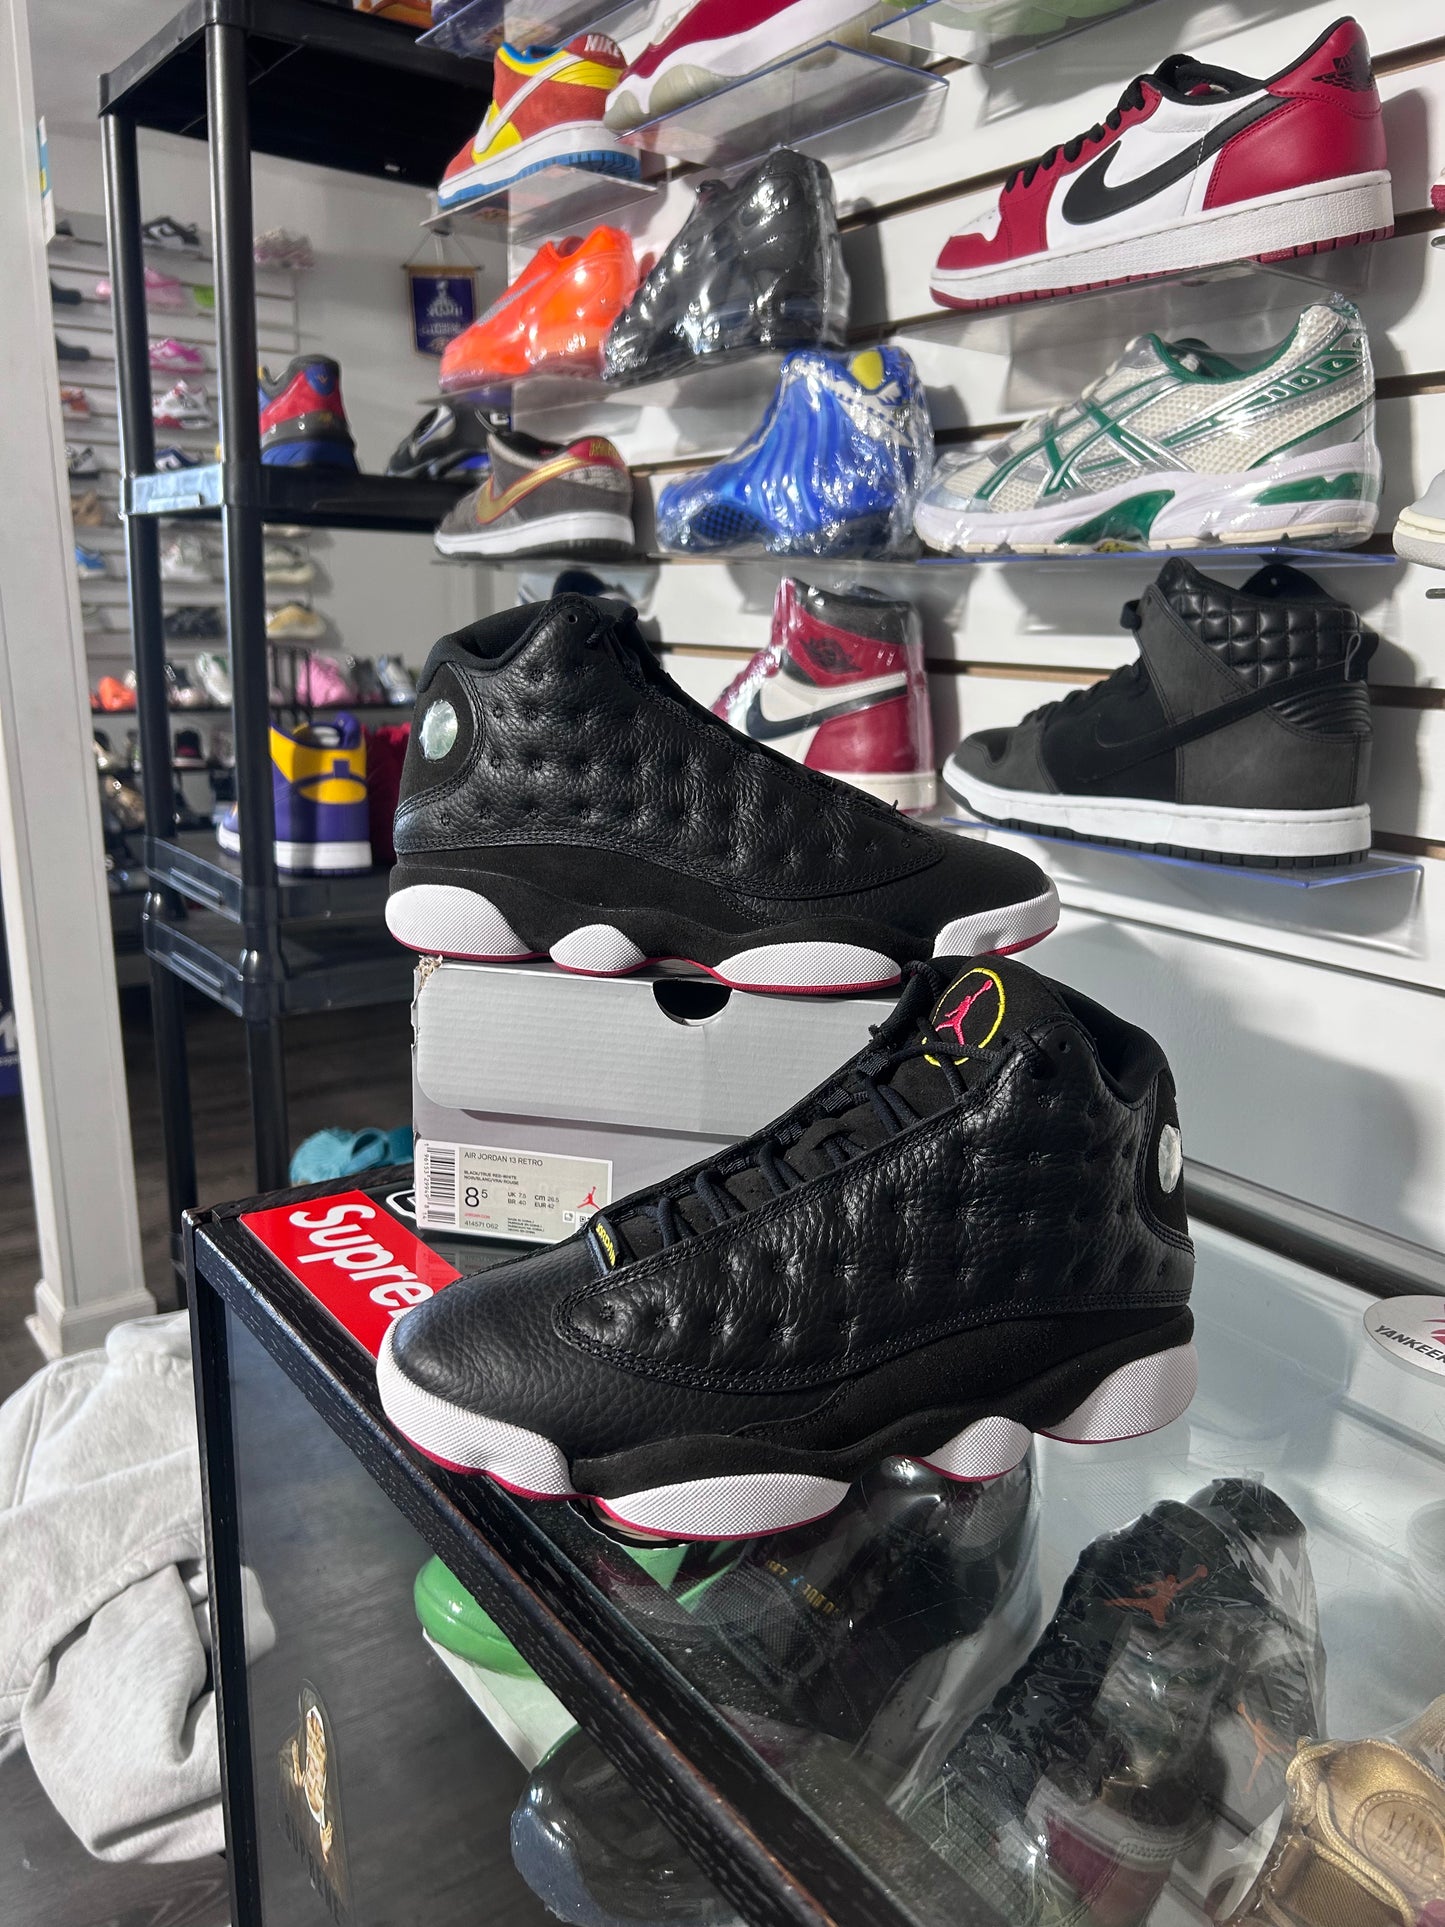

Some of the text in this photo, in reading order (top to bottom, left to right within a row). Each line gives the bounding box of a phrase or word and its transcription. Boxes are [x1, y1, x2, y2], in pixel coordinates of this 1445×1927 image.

[464, 1151, 543, 1167] AIR JORDAN 13 RETRO
[465, 1187, 480, 1208] 8
[534, 1194, 546, 1202] cm
[534, 1201, 547, 1209] EUR
[464, 1219, 485, 1228] 414571
[289, 1203, 434, 1320] Supre
